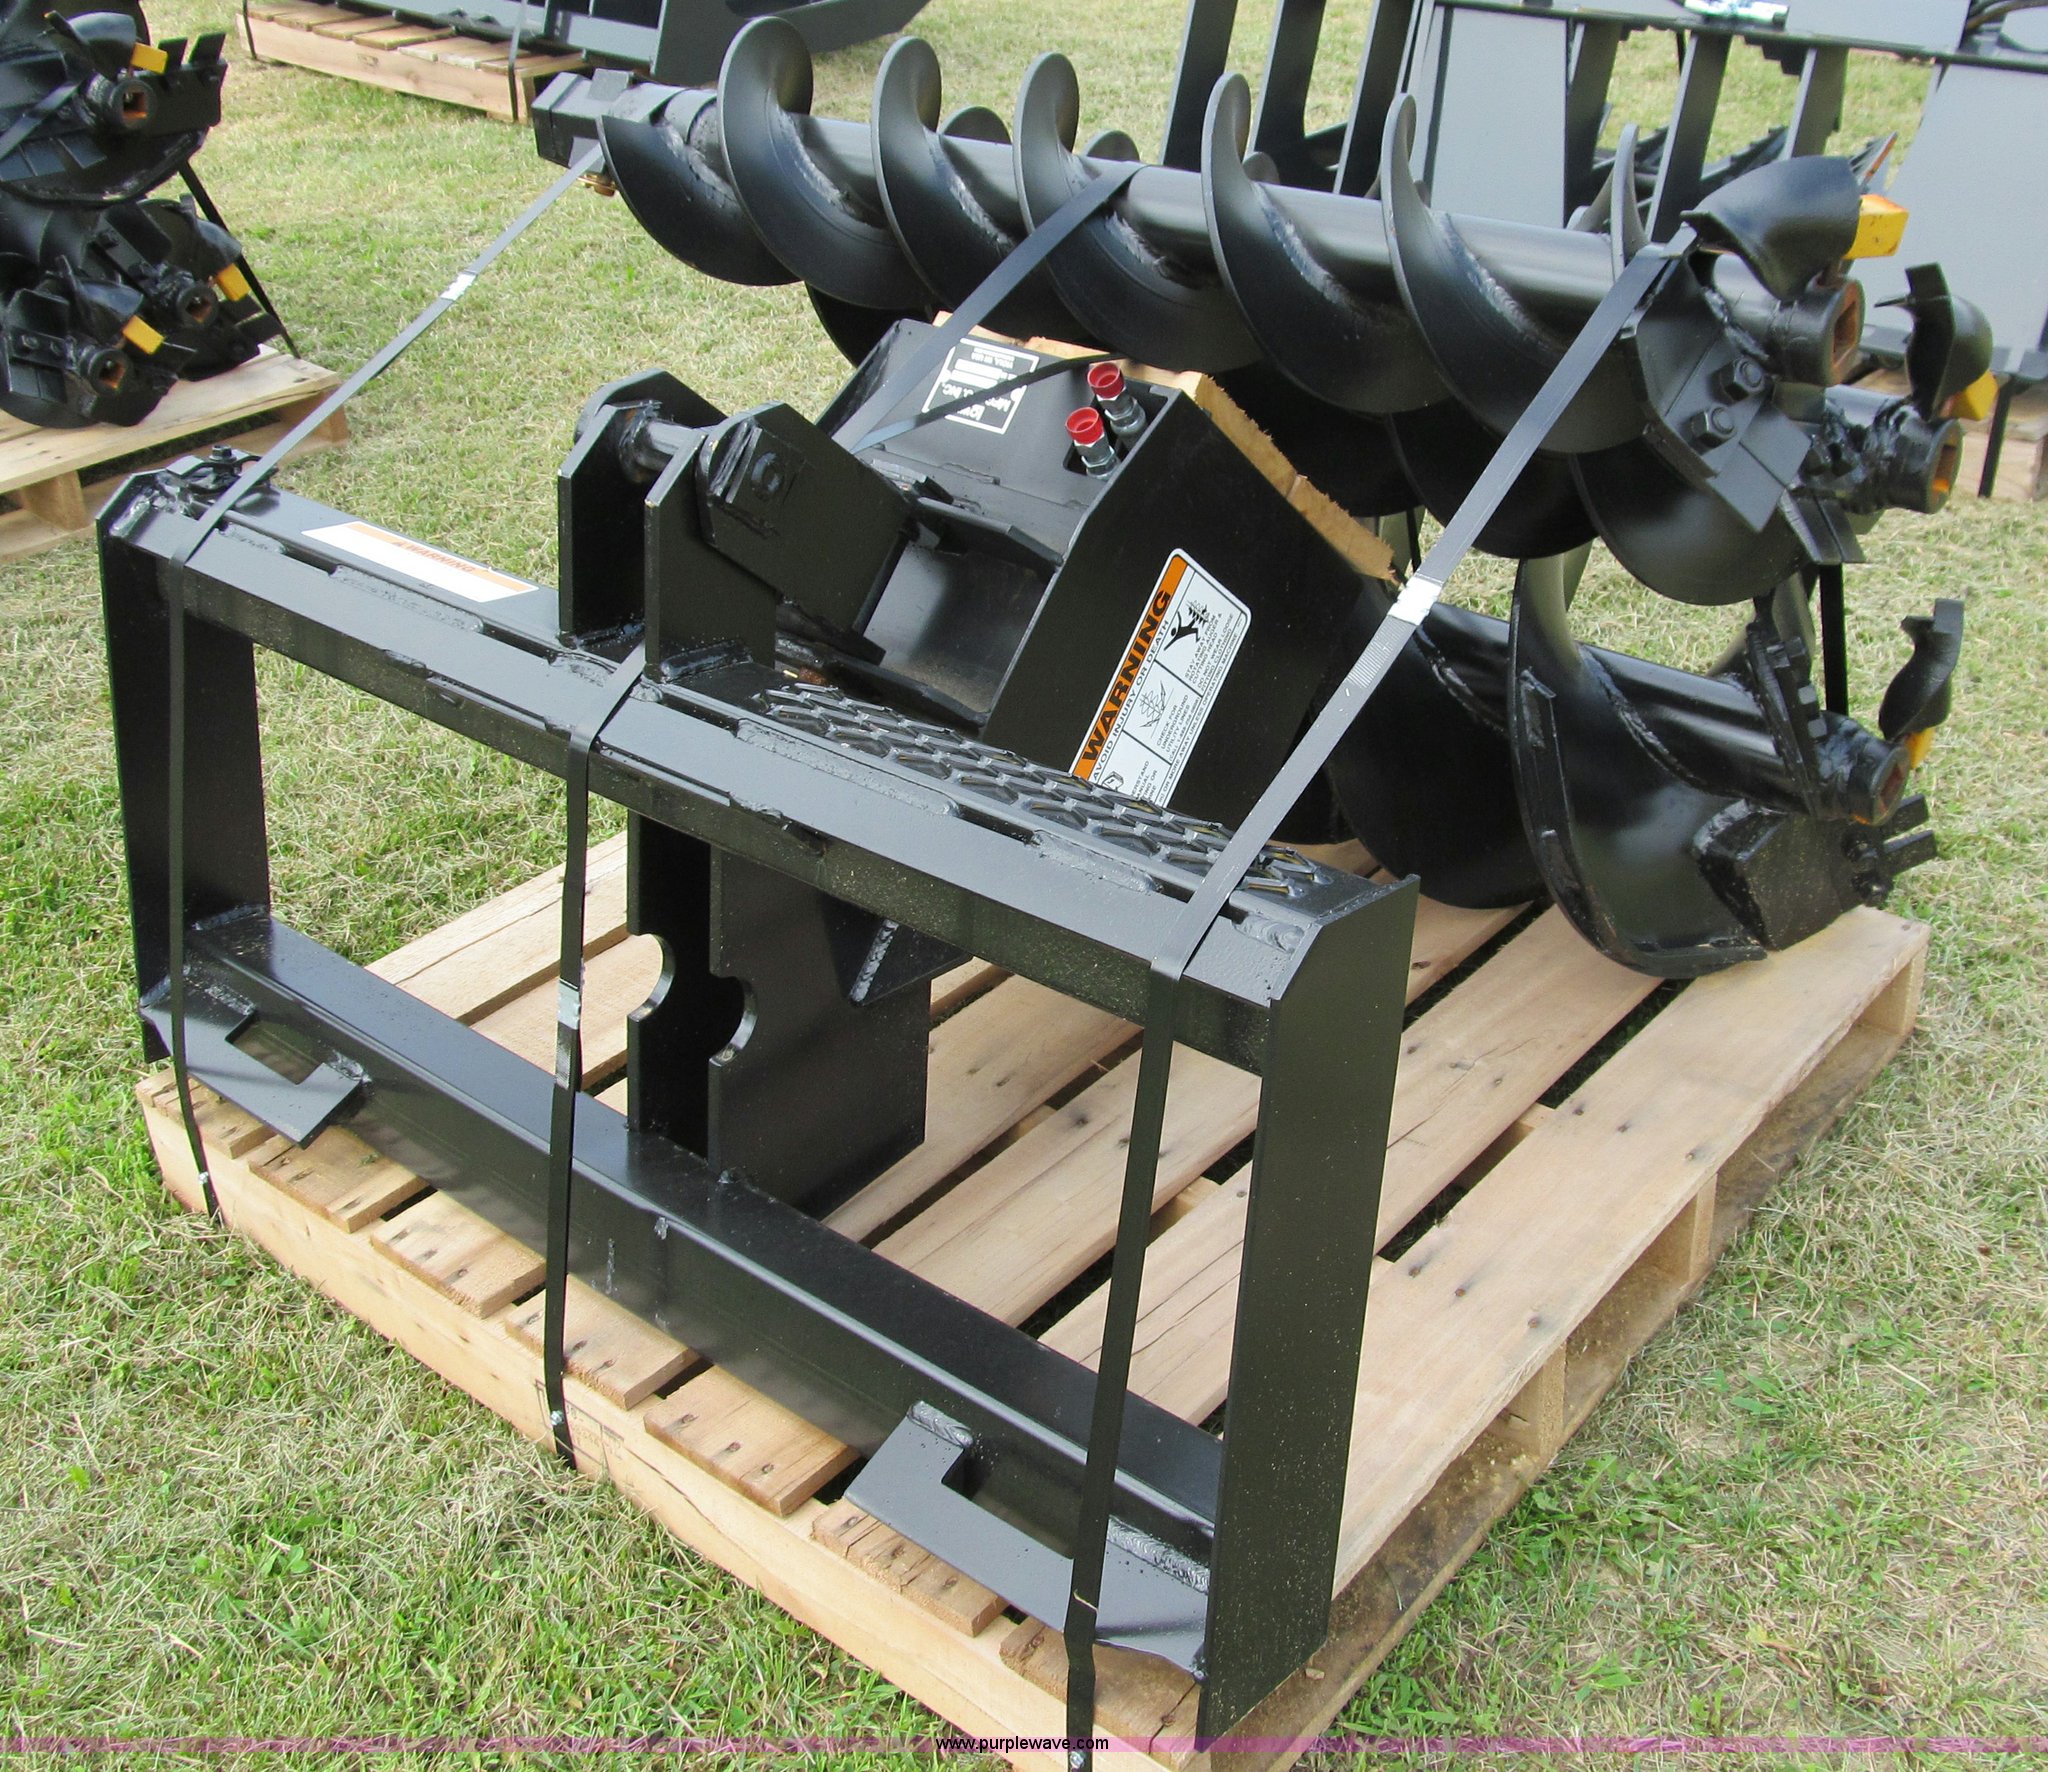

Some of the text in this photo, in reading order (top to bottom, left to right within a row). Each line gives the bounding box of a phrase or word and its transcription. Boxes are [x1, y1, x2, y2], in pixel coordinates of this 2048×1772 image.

[1082, 589, 1170, 763] WARNING
[1184, 614, 1215, 678] STAY AWAY FROM
[1188, 645, 1206, 681] ROTATING
[1205, 619, 1218, 644] AUGER
[1192, 631, 1217, 684] CUTTING HEAD
[1197, 612, 1233, 688] DO NOT WEAR LOOSE
[1201, 627, 1231, 691] FITTING CLOTHING
[1092, 619, 1168, 780] AVOID INJURY OR DEATH
[1156, 703, 1177, 746] CHECK FOR
[1161, 694, 1188, 750] UNDERGROUND
[1162, 780, 1169, 792] OR
[1168, 758, 1180, 779] MORE
[1178, 735, 1190, 757] AWAY
[1189, 706, 1203, 735] UNLESS
[1202, 665, 1222, 705] OPERATING
[1221, 633, 1237, 664] MACHINE
[1165, 703, 1189, 752] UTILITY LINES
[1150, 769, 1157, 781] OR
